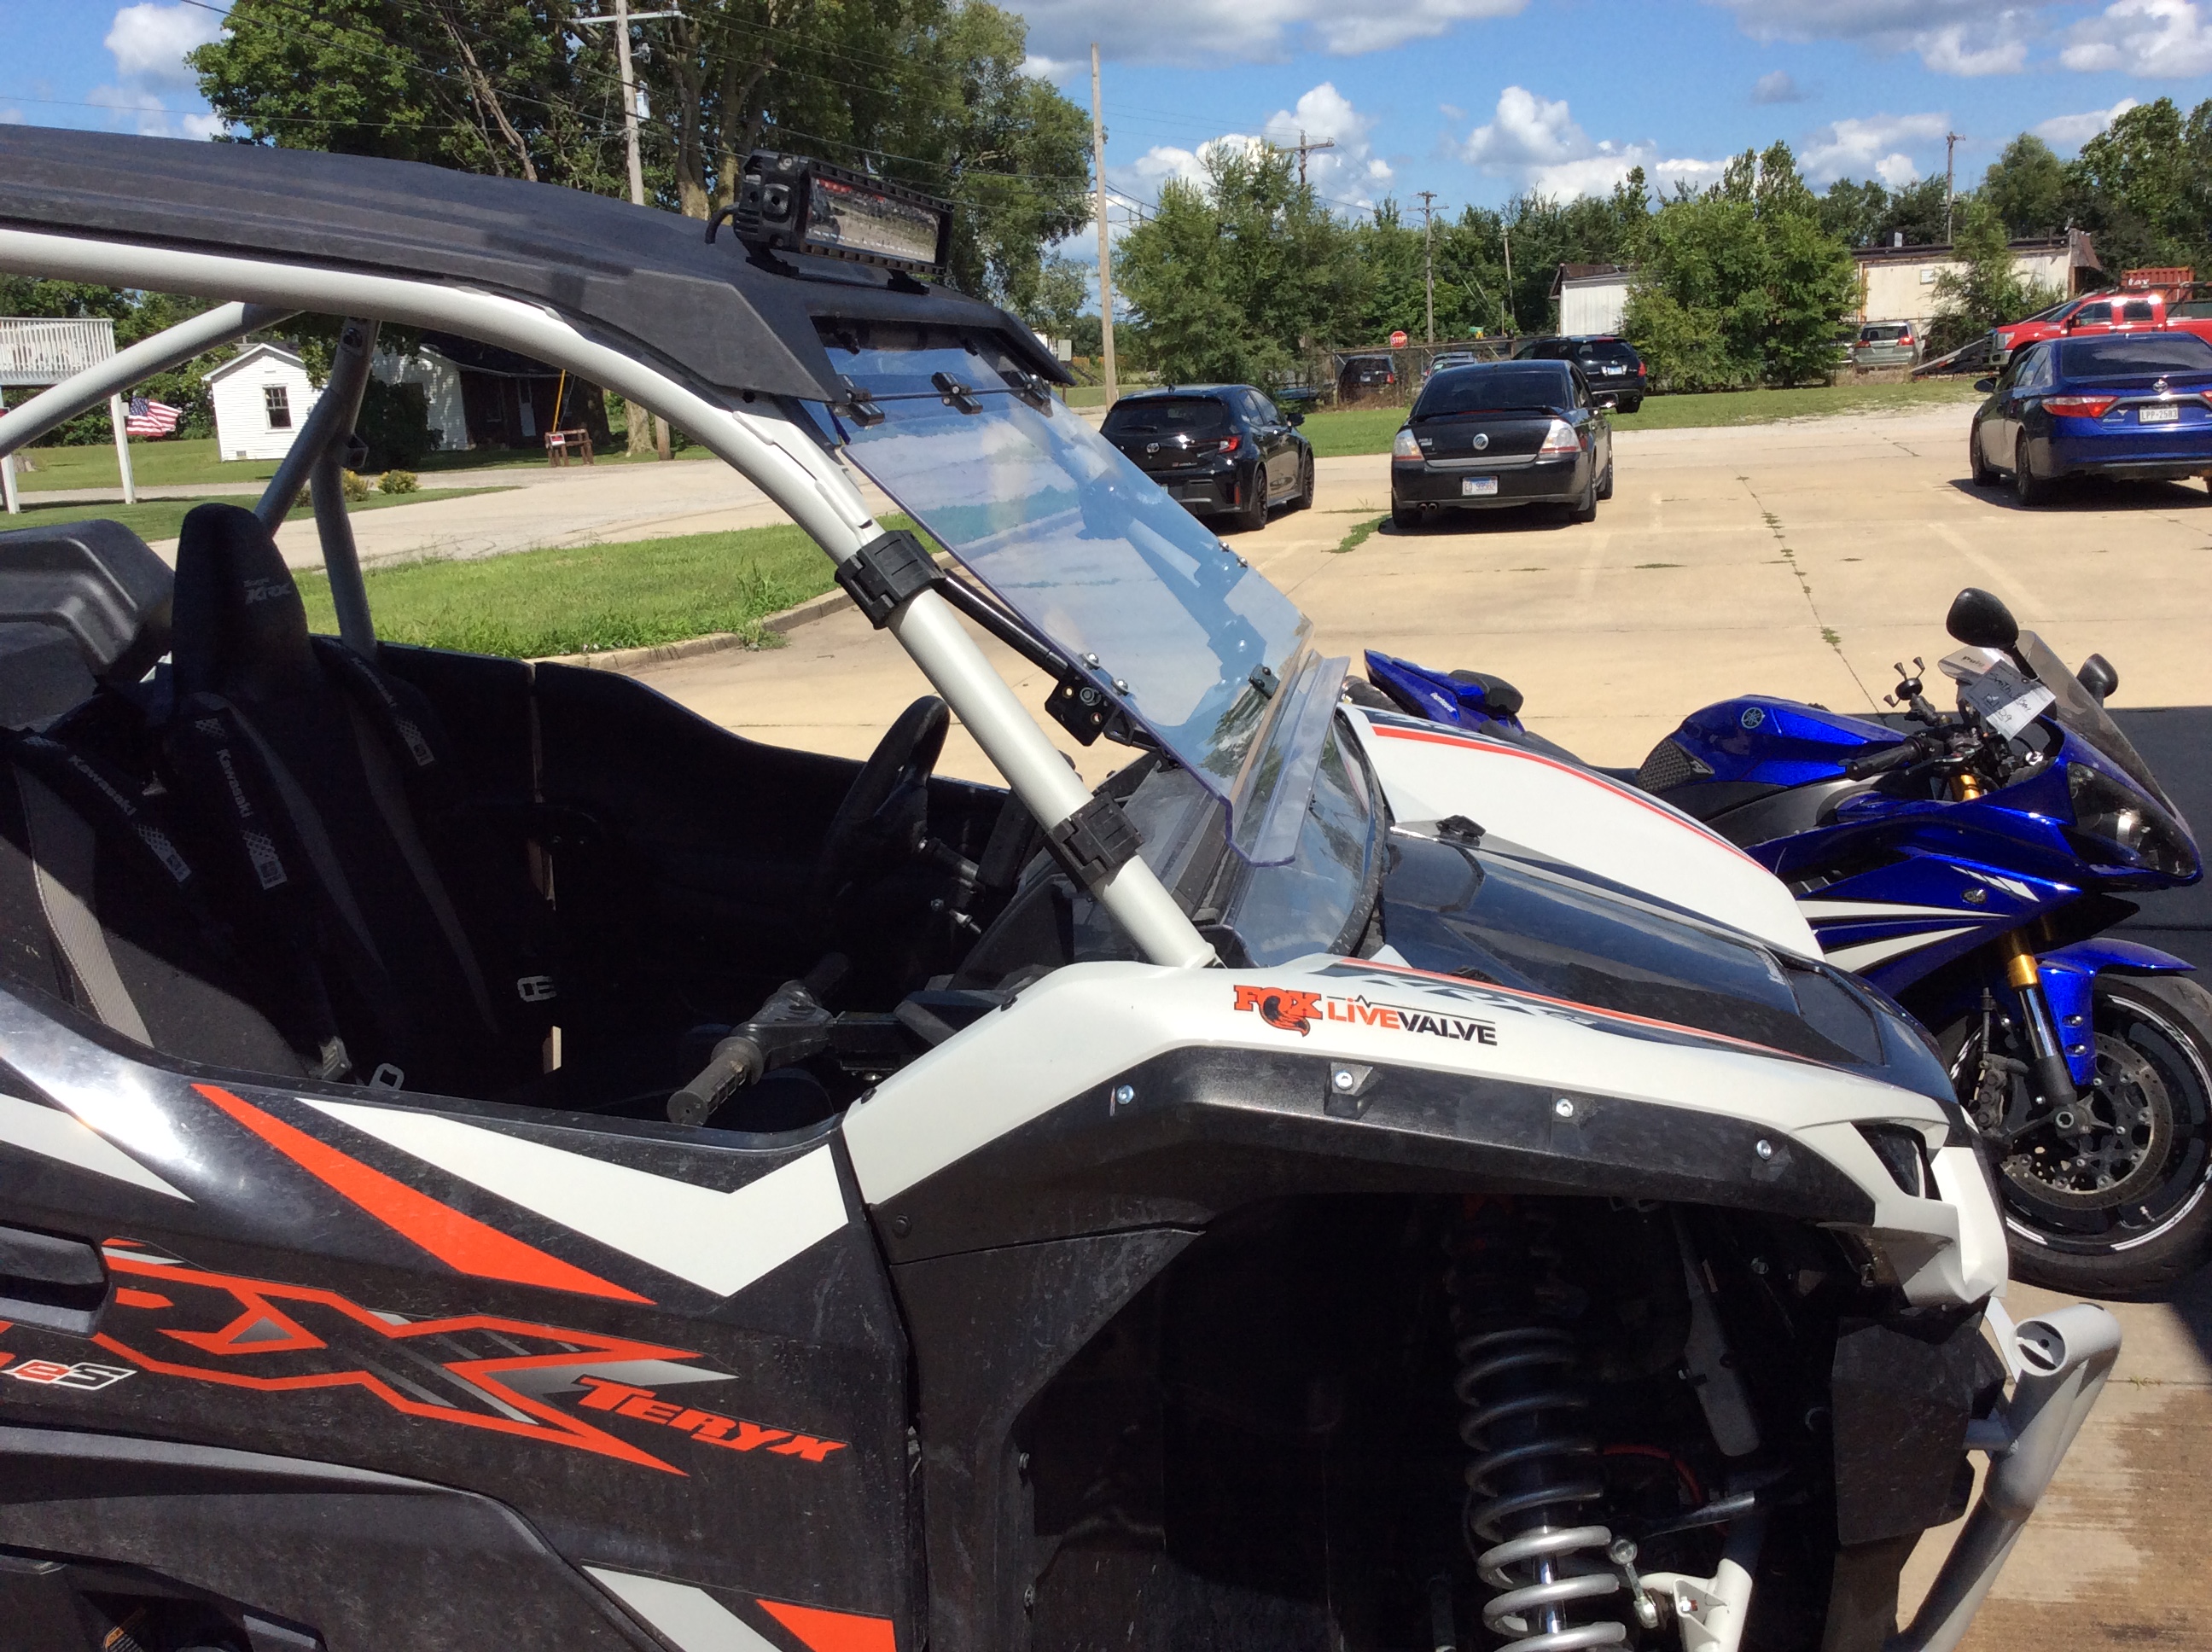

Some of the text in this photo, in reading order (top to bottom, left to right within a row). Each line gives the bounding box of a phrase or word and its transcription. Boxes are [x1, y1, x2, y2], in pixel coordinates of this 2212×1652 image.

[1391, 335, 1406, 345] STOP
[67, 755, 137, 816] Kawasaki
[216, 748, 253, 818] Kawasaki
[1233, 985, 1323, 1032] FOX
